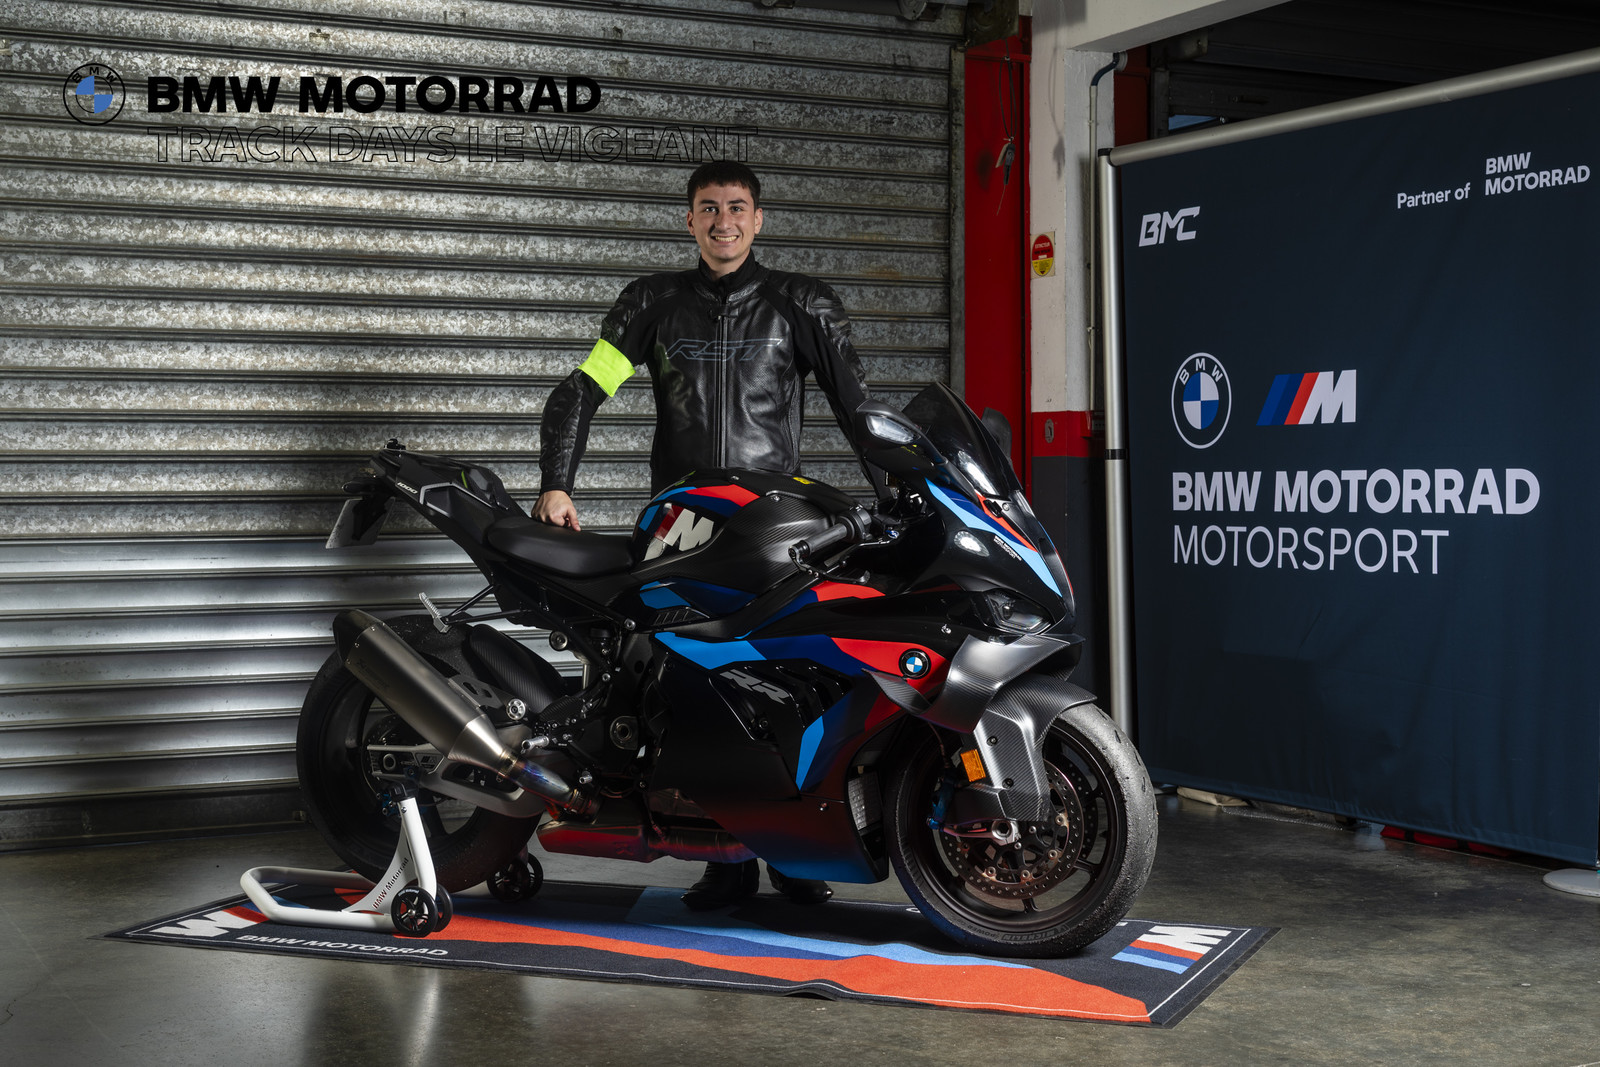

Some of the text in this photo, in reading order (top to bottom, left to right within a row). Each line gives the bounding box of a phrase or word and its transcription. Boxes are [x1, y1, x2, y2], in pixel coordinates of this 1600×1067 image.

[1485, 152, 1532, 175] BMW
[1484, 164, 1591, 197] MOTORRAD
[1397, 182, 1471, 210] Partner of
[1138, 206, 1201, 248] BMC
[664, 338, 784, 362] RST
[1179, 357, 1223, 385] BMW
[1172, 467, 1541, 516] BMW MOTORRAD
[1173, 524, 1450, 575] MOTORSPORT
[385, 857, 409, 891] Motorrad
[236, 934, 449, 956] BMW MOTORRAD
